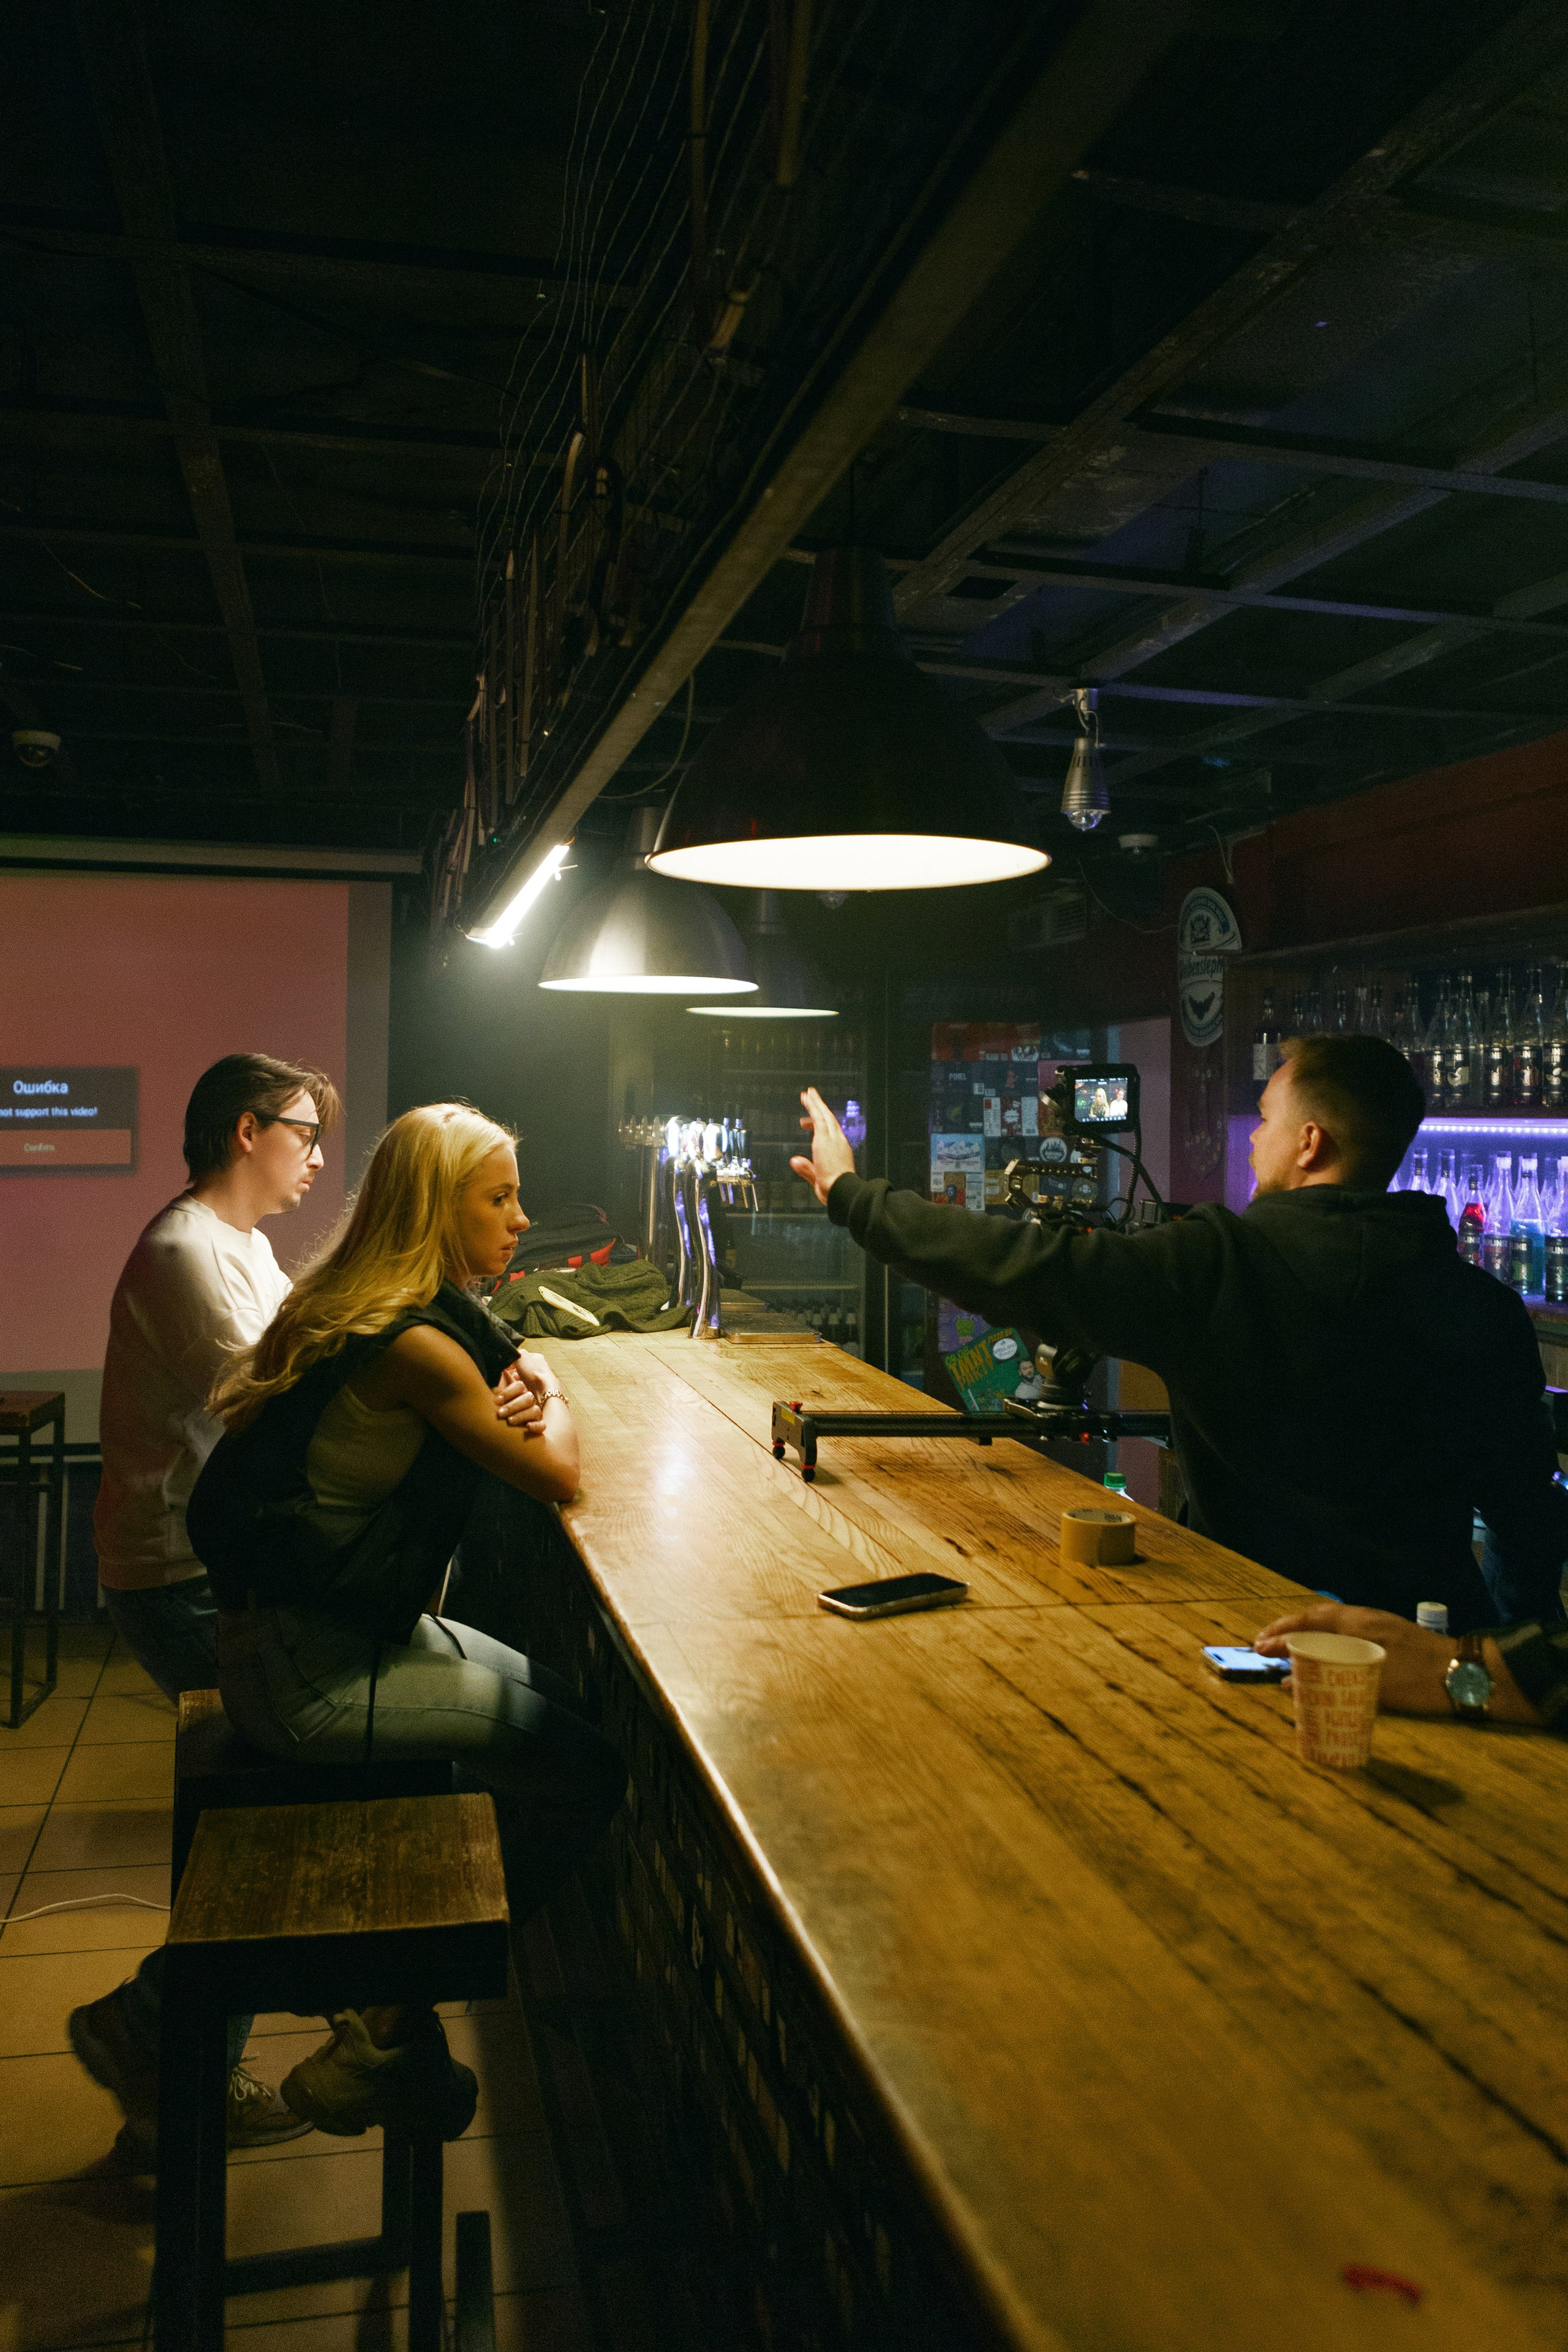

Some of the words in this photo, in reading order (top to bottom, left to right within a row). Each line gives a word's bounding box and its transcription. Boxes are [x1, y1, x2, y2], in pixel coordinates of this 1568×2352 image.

[13, 1080, 69, 1095] Ошибка
[15, 1107, 50, 1118] support
[51, 1106, 69, 1117] this
[70, 1106, 98, 1117] video!
